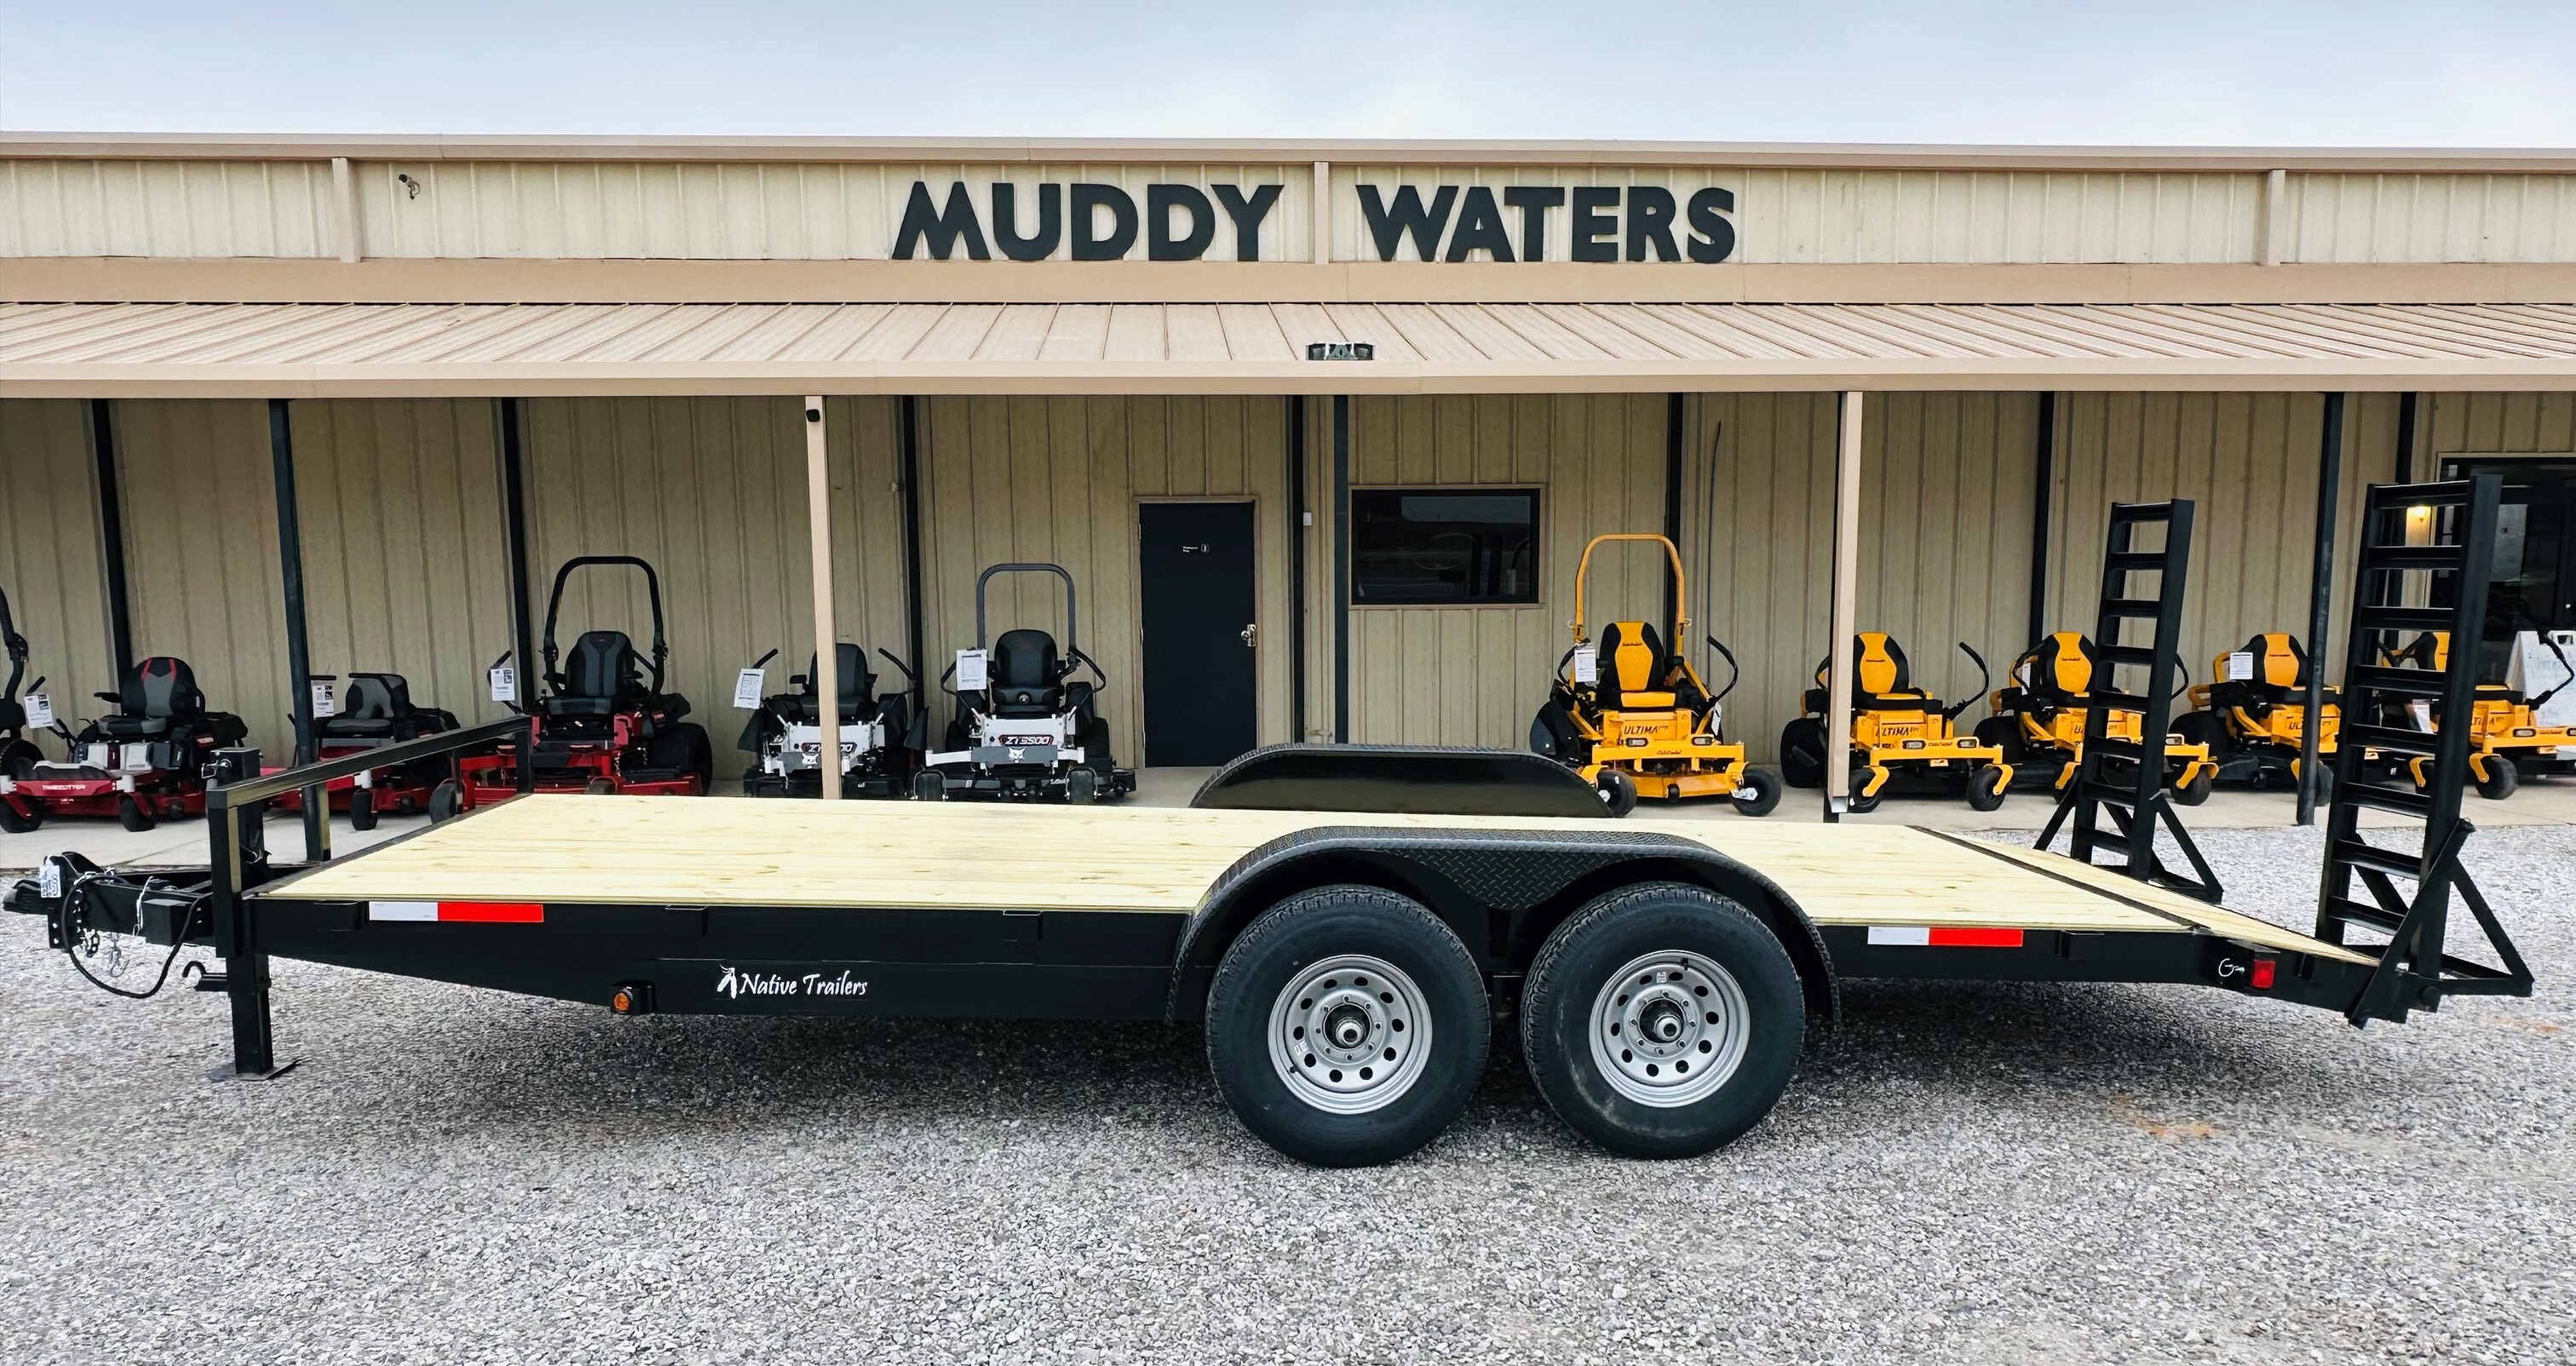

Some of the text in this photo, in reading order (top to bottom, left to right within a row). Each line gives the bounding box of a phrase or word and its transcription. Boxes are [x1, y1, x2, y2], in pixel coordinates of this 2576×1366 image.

[891, 181, 1735, 263] MUDDY WATERS
[1624, 725, 1658, 734] ULTIMA
[739, 970, 868, 996] Native Trailers
